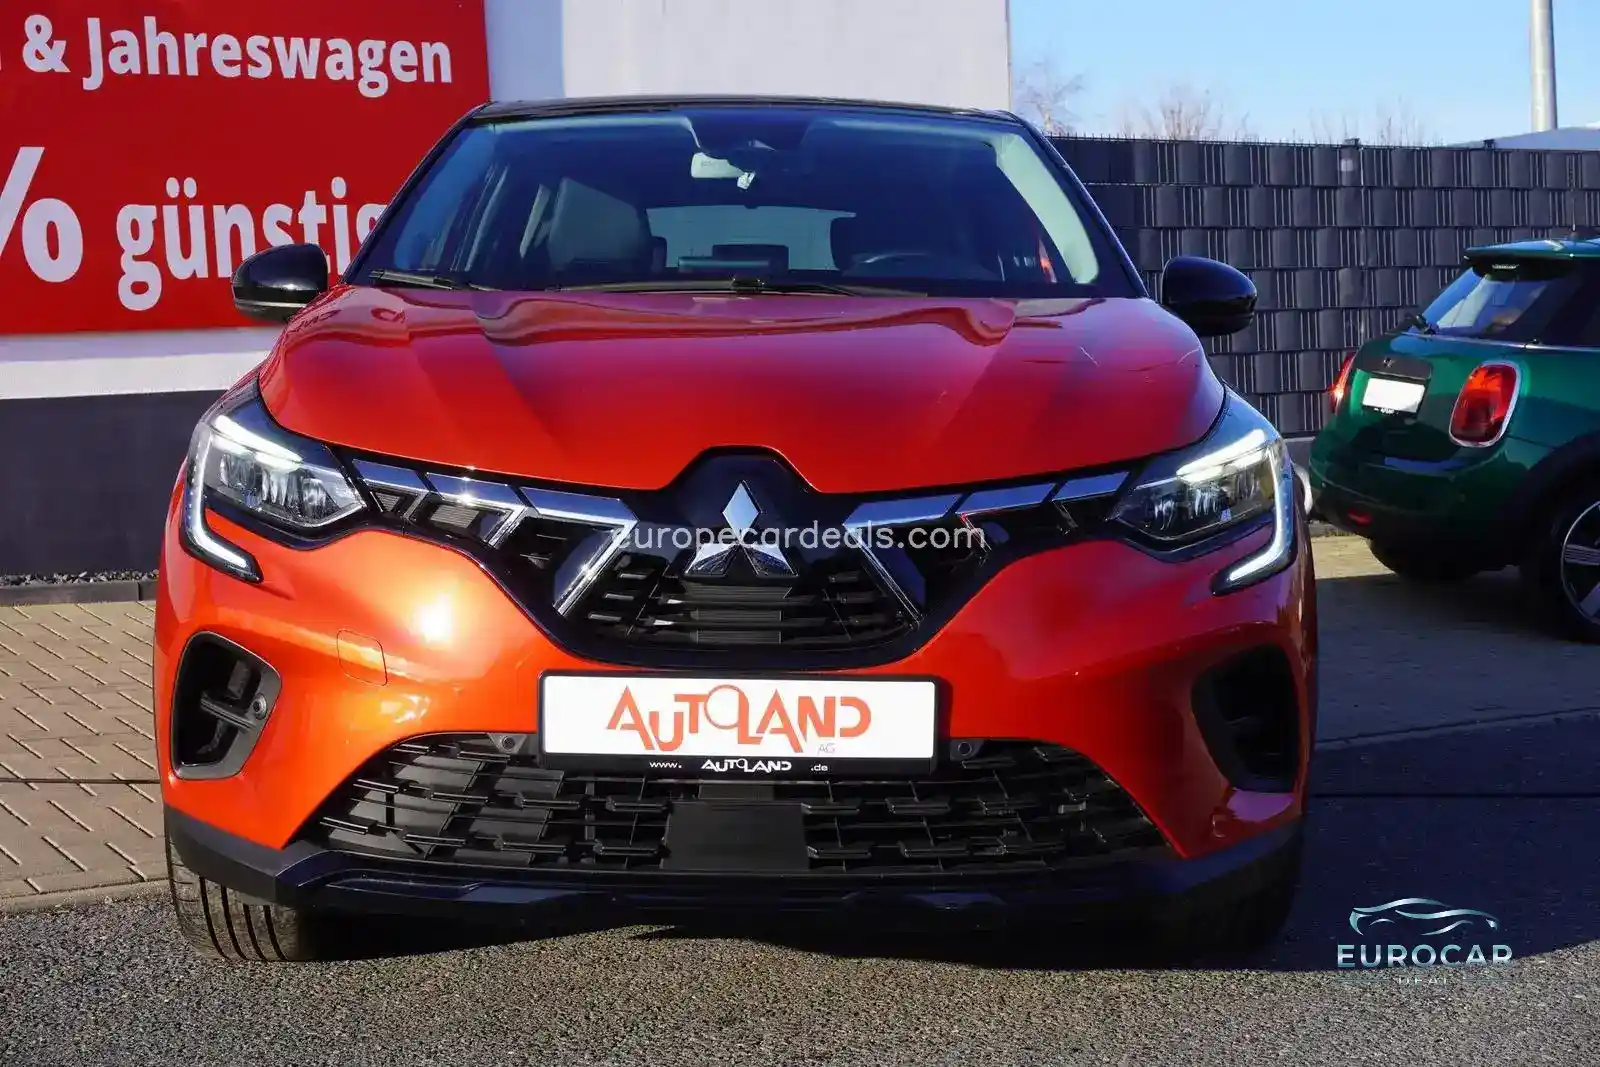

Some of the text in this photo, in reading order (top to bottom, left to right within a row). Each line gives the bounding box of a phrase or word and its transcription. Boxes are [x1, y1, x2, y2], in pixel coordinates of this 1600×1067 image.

[22, 14, 452, 98] & Jahreswagen
[606, 684, 872, 753] AUTOLAND
[649, 757, 828, 773] www. AUTOLAND .de
